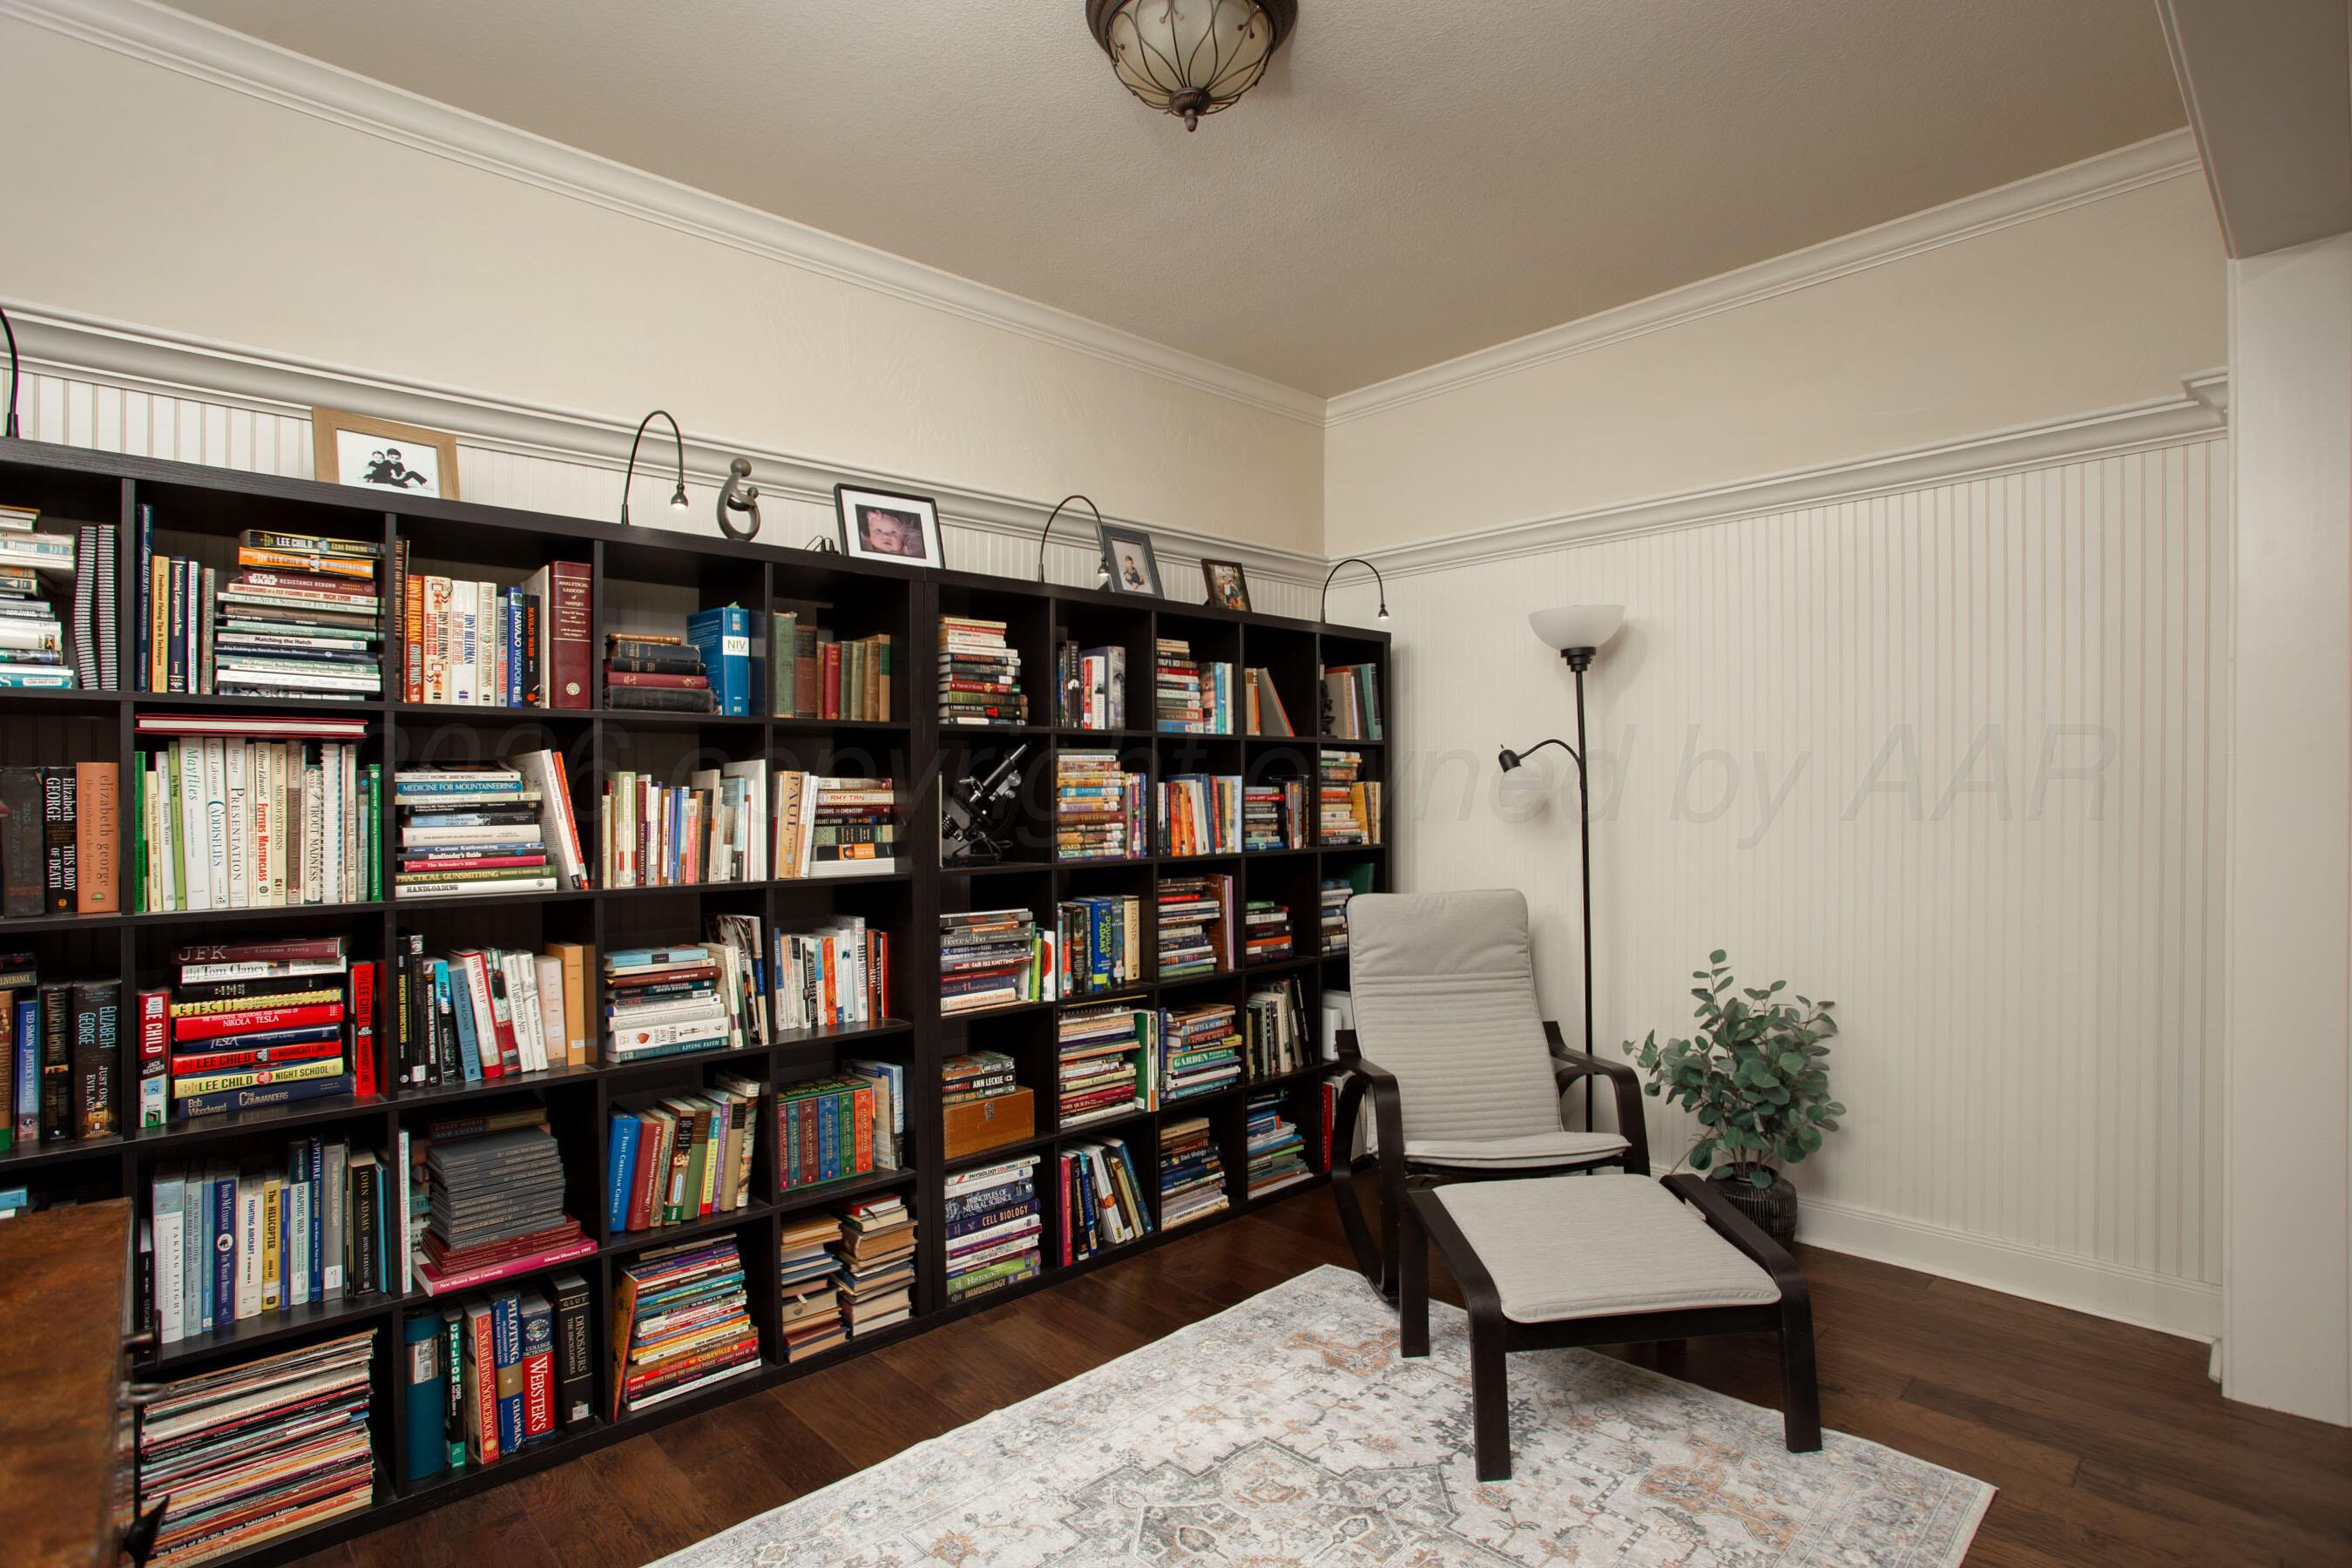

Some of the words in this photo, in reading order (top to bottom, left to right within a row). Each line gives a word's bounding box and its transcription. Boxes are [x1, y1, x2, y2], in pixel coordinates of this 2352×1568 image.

[276, 537, 291, 547] LEE
[292, 538, 313, 548] CHILD
[279, 578, 314, 587] RESISTANCE
[408, 580, 422, 600] TONY
[408, 600, 422, 642] HILLERMAN
[438, 612, 449, 627] TONY
[464, 614, 475, 630] TONY
[254, 636, 281, 645] Matching
[438, 627, 449, 659] HILLERMAN
[464, 631, 475, 665] HILLERMAN
[727, 639, 746, 650] NIV
[409, 644, 421, 666] COYOTE
[409, 666, 422, 686] WAITS
[231, 749, 240, 774] Borger
[84, 780, 93, 789] the
[185, 748, 199, 801] Mayflies
[46, 777, 61, 821] GEORGE
[63, 778, 76, 821] Elizabeth
[99, 775, 114, 836] elizabeth
[84, 794, 93, 836] punishment
[258, 802, 268, 833] FLYTYERS
[310, 805, 319, 835] TROUT
[207, 801, 226, 867] CADDISFLIES
[231, 787, 245, 881] PRESENTATION
[50, 848, 60, 857] OF
[64, 843, 75, 866] THIS
[258, 835, 268, 882] MASTERCLASS
[309, 838, 319, 882] MADNESS
[49, 859, 61, 889] DEATH
[97, 843, 111, 887] george
[64, 867, 76, 891] BODY
[395, 872, 442, 882] PRACTICAL
[443, 870, 499, 881] GUNSMITHING
[407, 884, 458, 893] HANDLOADING
[472, 958, 481, 970] THE
[857, 945, 866, 963] BIG
[202, 965, 226, 976] Tom
[229, 963, 267, 975] Clancy
[359, 980, 370, 1000] LEE
[474, 971, 484, 994] MARCH
[808, 962, 816, 999] MIDDLESEX
[179, 1002, 234, 1014] EJECT!
[479, 995, 487, 1004] UP
[25, 1010, 35, 1023] TED
[223, 1017, 251, 1027] NIKOLA
[255, 1015, 280, 1024] TESLA
[359, 1002, 370, 1028] CHILD
[25, 1024, 35, 1046] SIMON
[78, 1012, 97, 1045] GEORGE
[98, 1006, 117, 1049] ELIZABETH
[145, 1023, 163, 1053] CHILD
[210, 1037, 239, 1050] TESLA
[143, 1064, 166, 1075] REACHER
[146, 1060, 161, 1069] JACK
[195, 1057, 216, 1069] LEE
[219, 1052, 251, 1066] CHILD
[1174, 1053, 1208, 1067] GARDEN
[98, 1065, 108, 1086] JUST
[275, 1070, 297, 1080] NIGHT
[300, 1065, 329, 1078] SCHOOL
[973, 1080, 985, 1089] ANN
[985, 1076, 1004, 1085] LECKIE
[86, 1074, 96, 1094] EVIL
[199, 1079, 219, 1092] LEE
[221, 1075, 253, 1088] CHILD
[86, 1096, 95, 1112] ACT
[98, 1087, 108, 1105] ONE
[188, 1098, 202, 1107] Bob
[188, 1103, 227, 1115] Woodward
[620, 1136, 629, 1152] FIRST
[616, 1155, 626, 1186] CHRISTIAN
[969, 1168, 997, 1179] PHYSIOLOGY
[360, 1171, 368, 1196] JOHN
[267, 1190, 277, 1203] The
[296, 1186, 306, 1217] GRAPHIC
[612, 1188, 622, 1213] CHURCH
[963, 1200, 988, 1213] NEURAL
[988, 1194, 1011, 1206] SCIENCE
[967, 1192, 998, 1206] PRINCIPLES
[361, 1200, 369, 1231] ADAMS
[982, 1216, 997, 1227] CELL
[999, 1205, 1029, 1219] BIOLOGY
[267, 1206, 276, 1249] HELICOPTER
[296, 1219, 305, 1234] WAR
[221, 1254, 230, 1263] THE
[221, 1263, 230, 1281] WRIGHT
[480, 1269, 504, 1281] University
[968, 1270, 1000, 1284] HISTOLOGY
[221, 1281, 230, 1303] BROTHERS
[964, 1279, 1006, 1299] IMMUNOLOGY
[507, 1298, 519, 1364] PILOTING,
[450, 1323, 460, 1384] CHILTON
[478, 1331, 491, 1358] SOLAR
[575, 1315, 586, 1372] DINOSAURS
[481, 1358, 493, 1387] LIVING
[530, 1355, 548, 1431] WEBSTER'S
[482, 1387, 495, 1439] SOURCEBOOK
[512, 1399, 521, 1446] CHAPMAN
[157, 1548, 170, 1558] The
[172, 1544, 186, 1554] Best
[187, 1541, 196, 1551] of
[197, 1532, 222, 1547] AC/DC:
[223, 1524, 244, 1538] Guitar
[244, 1514, 274, 1530] Tablature
[275, 1505, 300, 1517] Edition.
